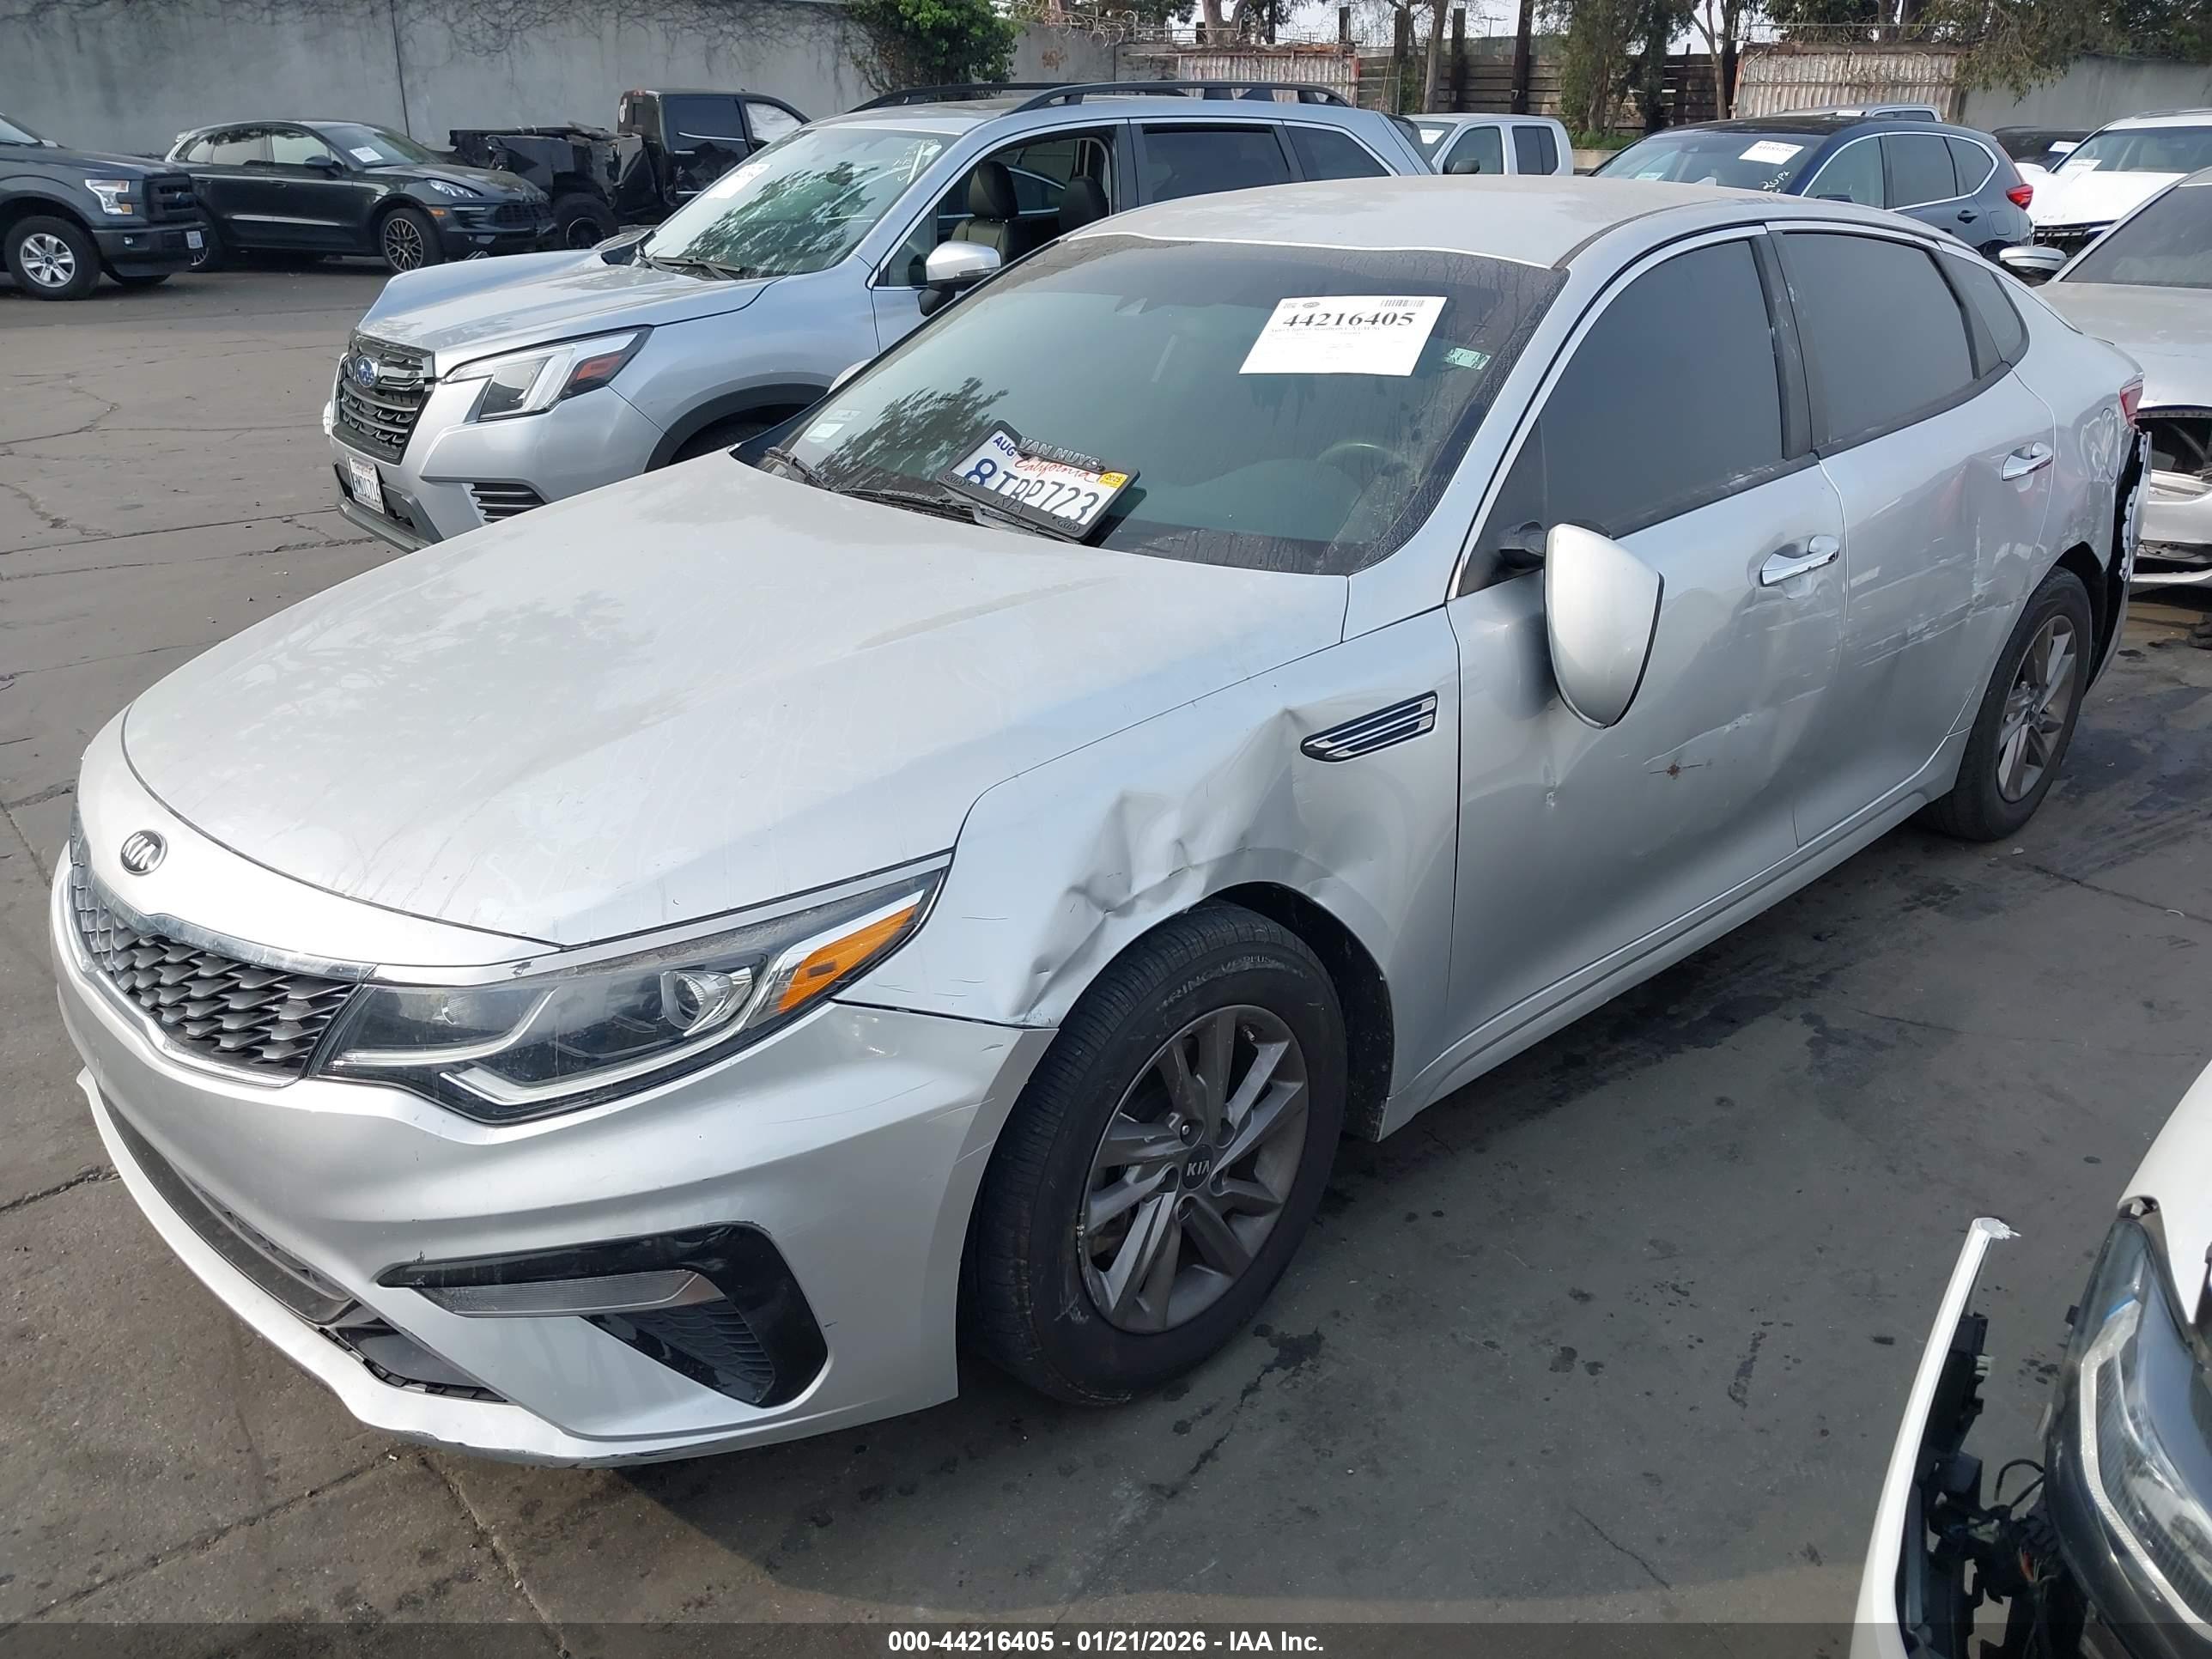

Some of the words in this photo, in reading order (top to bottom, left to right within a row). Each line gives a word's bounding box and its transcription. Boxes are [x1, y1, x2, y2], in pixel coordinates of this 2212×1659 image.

[1283, 311, 1417, 327] 44216405
[993, 435, 1016, 457] AUG
[1019, 437, 1053, 455] VAN
[1053, 447, 1101, 469] NUYS
[1014, 456, 1096, 483] California
[994, 495, 1024, 514] KIA
[122, 833, 155, 869] KIA
[1187, 1160, 1209, 1176] KIA
